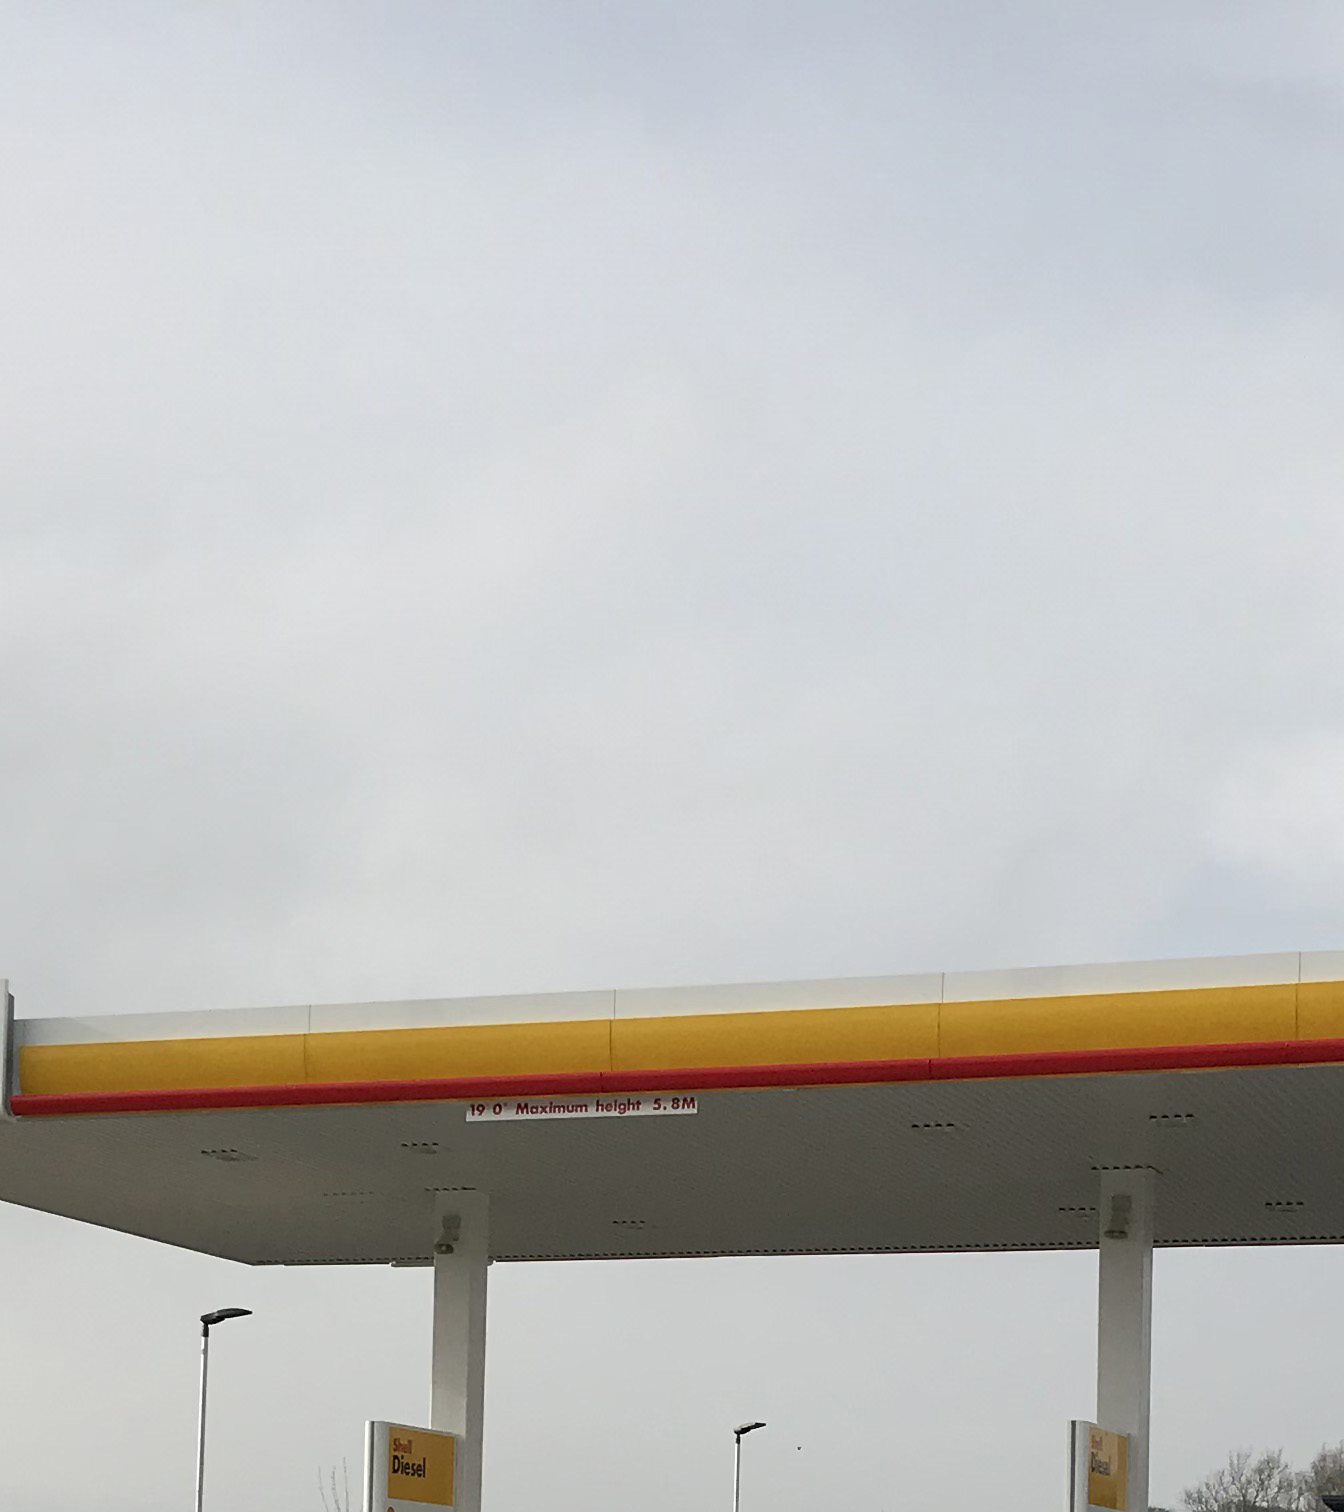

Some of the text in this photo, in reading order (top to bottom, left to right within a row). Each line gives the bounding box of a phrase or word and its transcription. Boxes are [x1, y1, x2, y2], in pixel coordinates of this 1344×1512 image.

[515, 1101, 589, 1115] Maximum
[595, 1098, 642, 1114] height
[392, 1454, 426, 1478] Diesel
